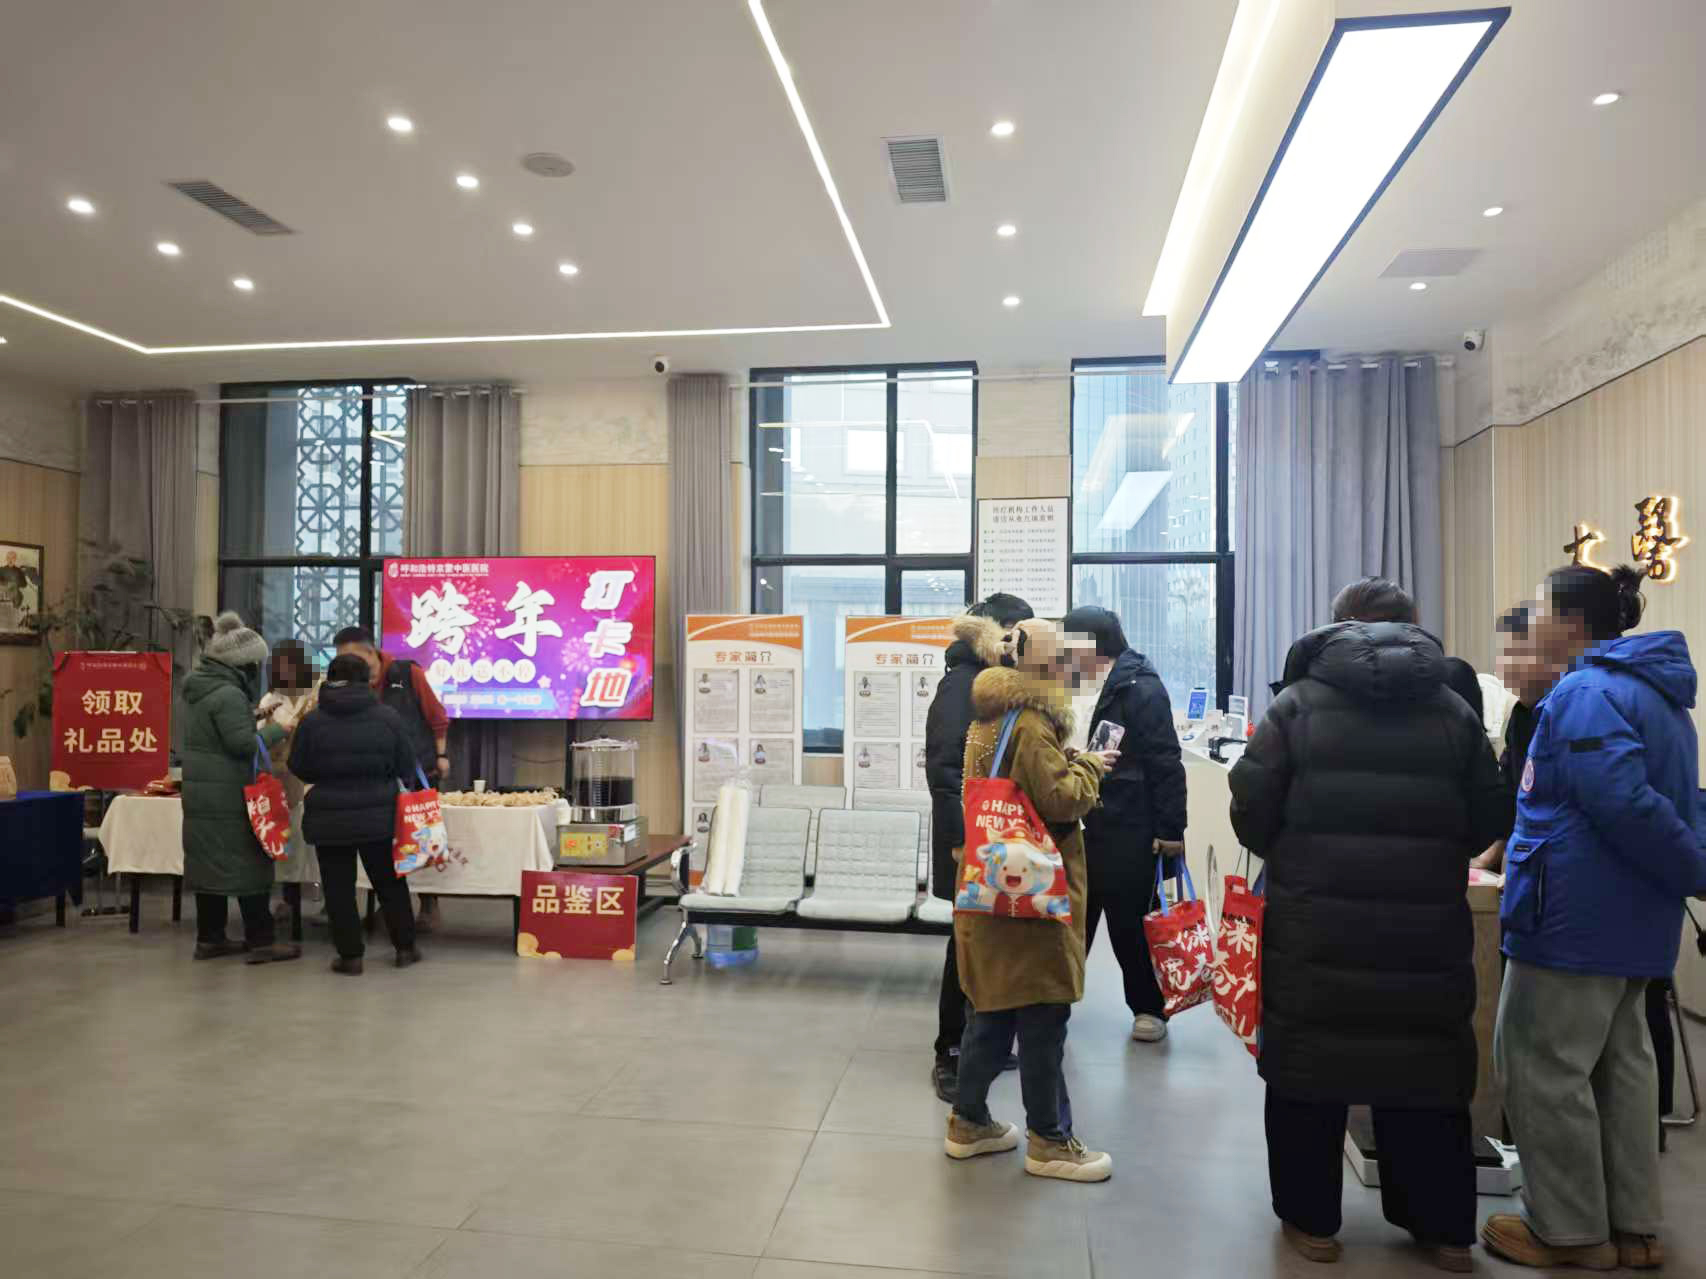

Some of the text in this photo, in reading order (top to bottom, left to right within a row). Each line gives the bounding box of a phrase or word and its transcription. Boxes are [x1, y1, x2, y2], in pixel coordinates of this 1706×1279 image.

[406, 581, 563, 657] 跨年
[581, 570, 635, 708] 打卡地
[715, 651, 772, 663] 专家简介
[875, 653, 934, 665] 专家简介
[81, 689, 144, 716] 领取
[63, 727, 158, 754] 礼品处
[532, 884, 625, 916] 品鉴区
